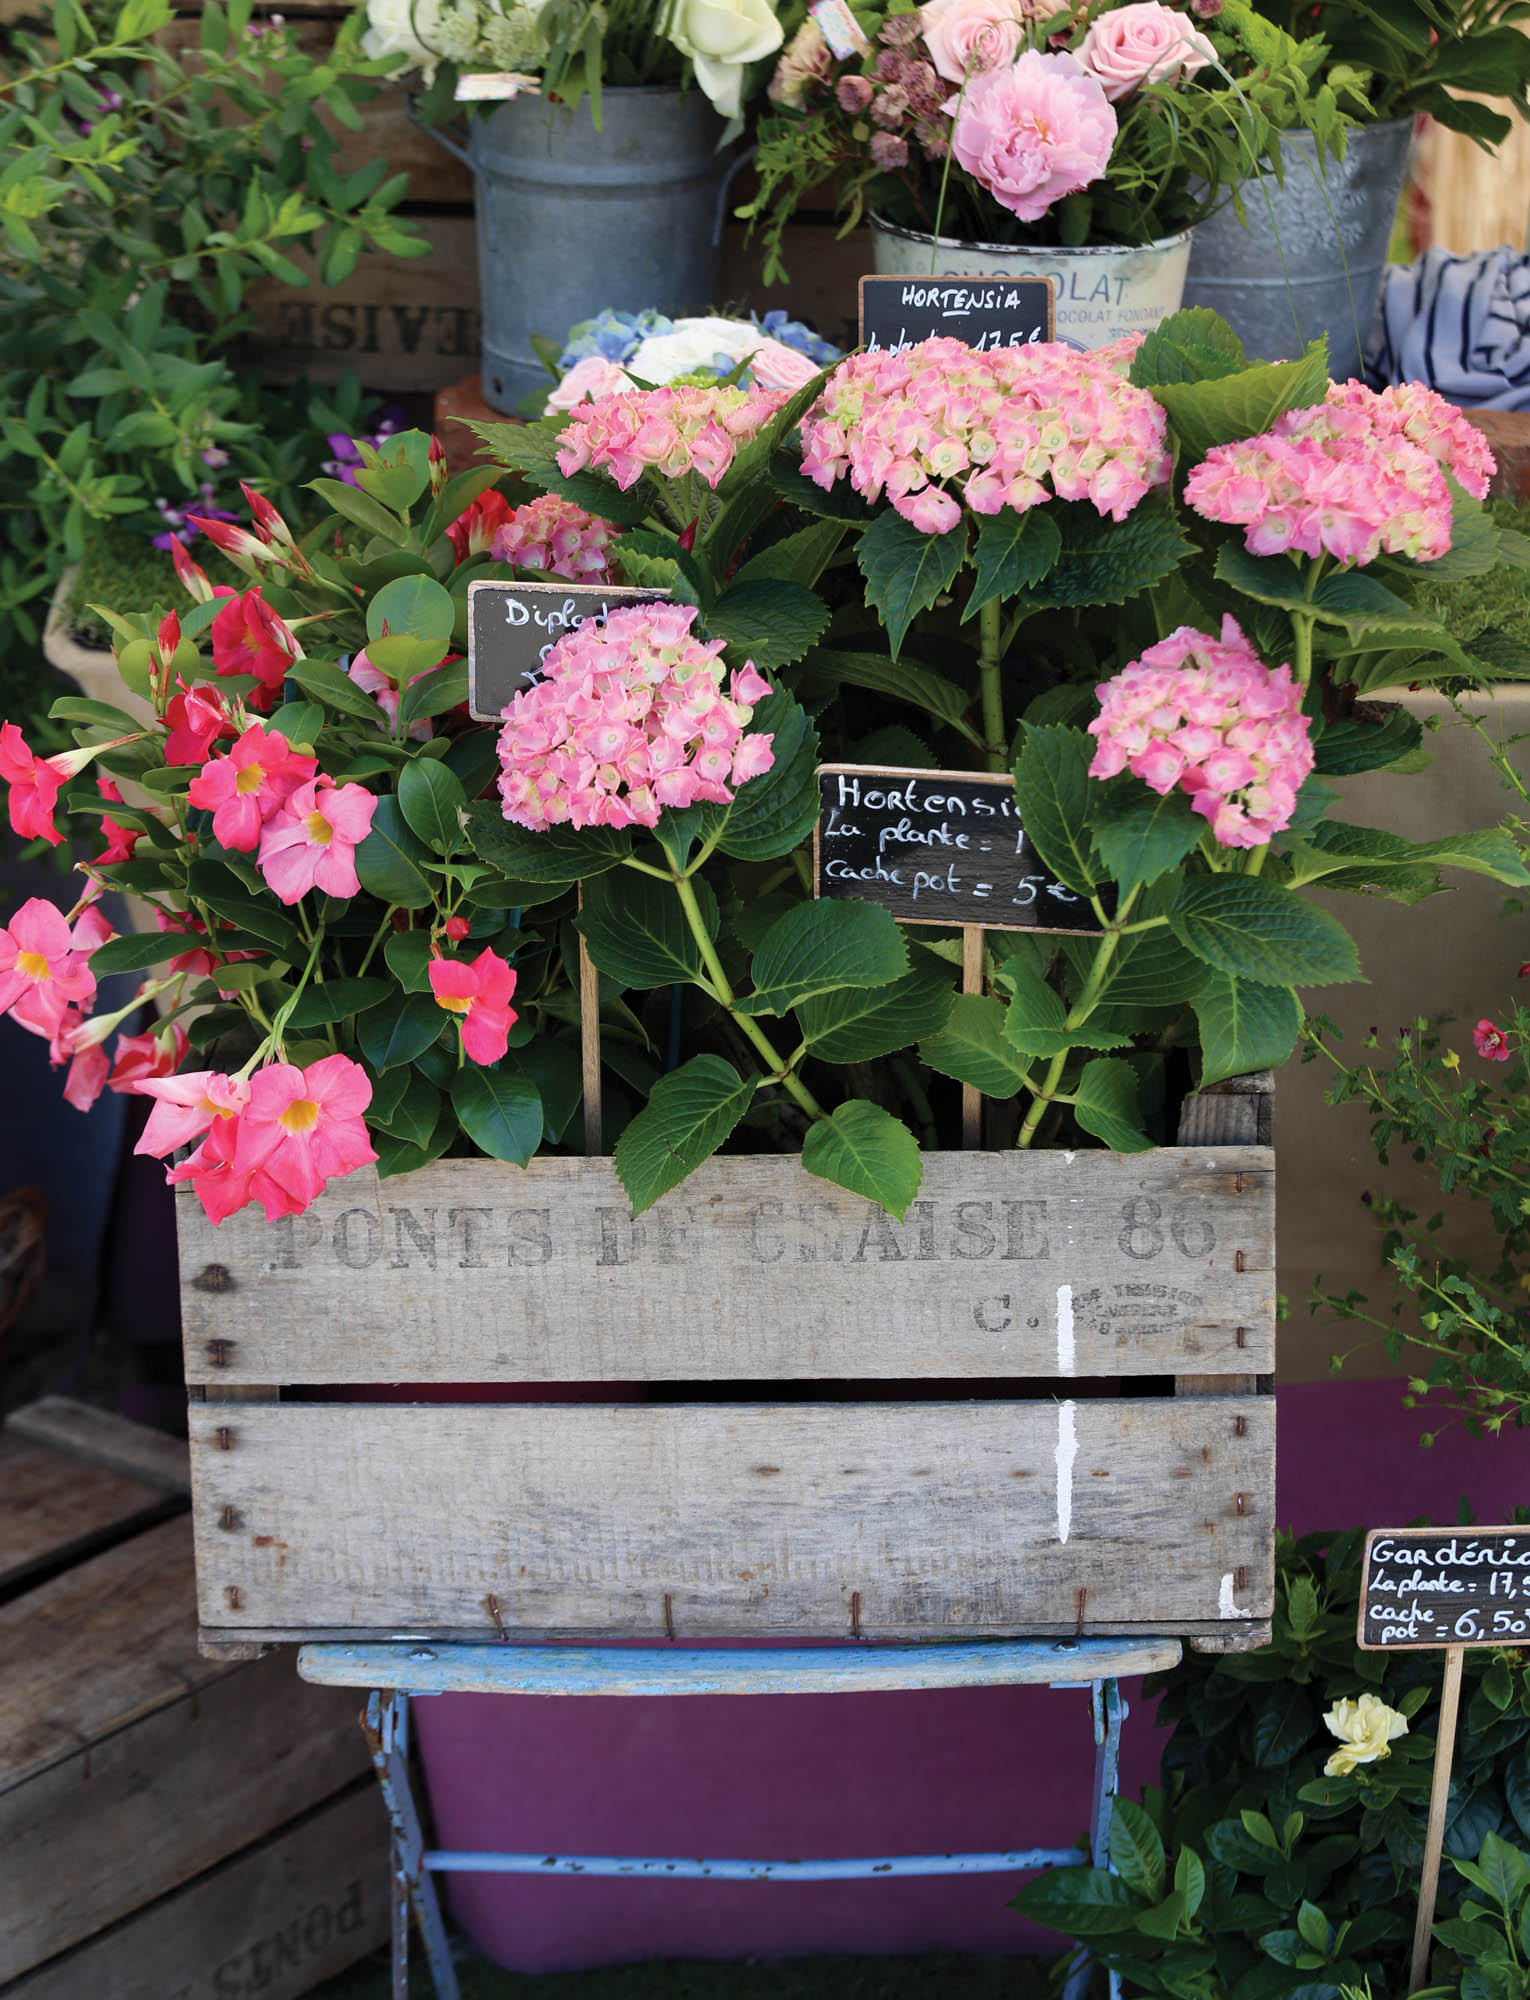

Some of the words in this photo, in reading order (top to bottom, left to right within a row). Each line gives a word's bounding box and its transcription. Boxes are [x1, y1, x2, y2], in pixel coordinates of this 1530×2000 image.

[824, 808, 862, 837] La
[879, 817, 970, 853] plante
[912, 863, 961, 900] pot
[268, 1207, 553, 1270] PONTS
[1116, 1195, 1218, 1261] 86
[1381, 1621, 1419, 1645] pot
[1454, 1608, 1530, 1641] 6,50
